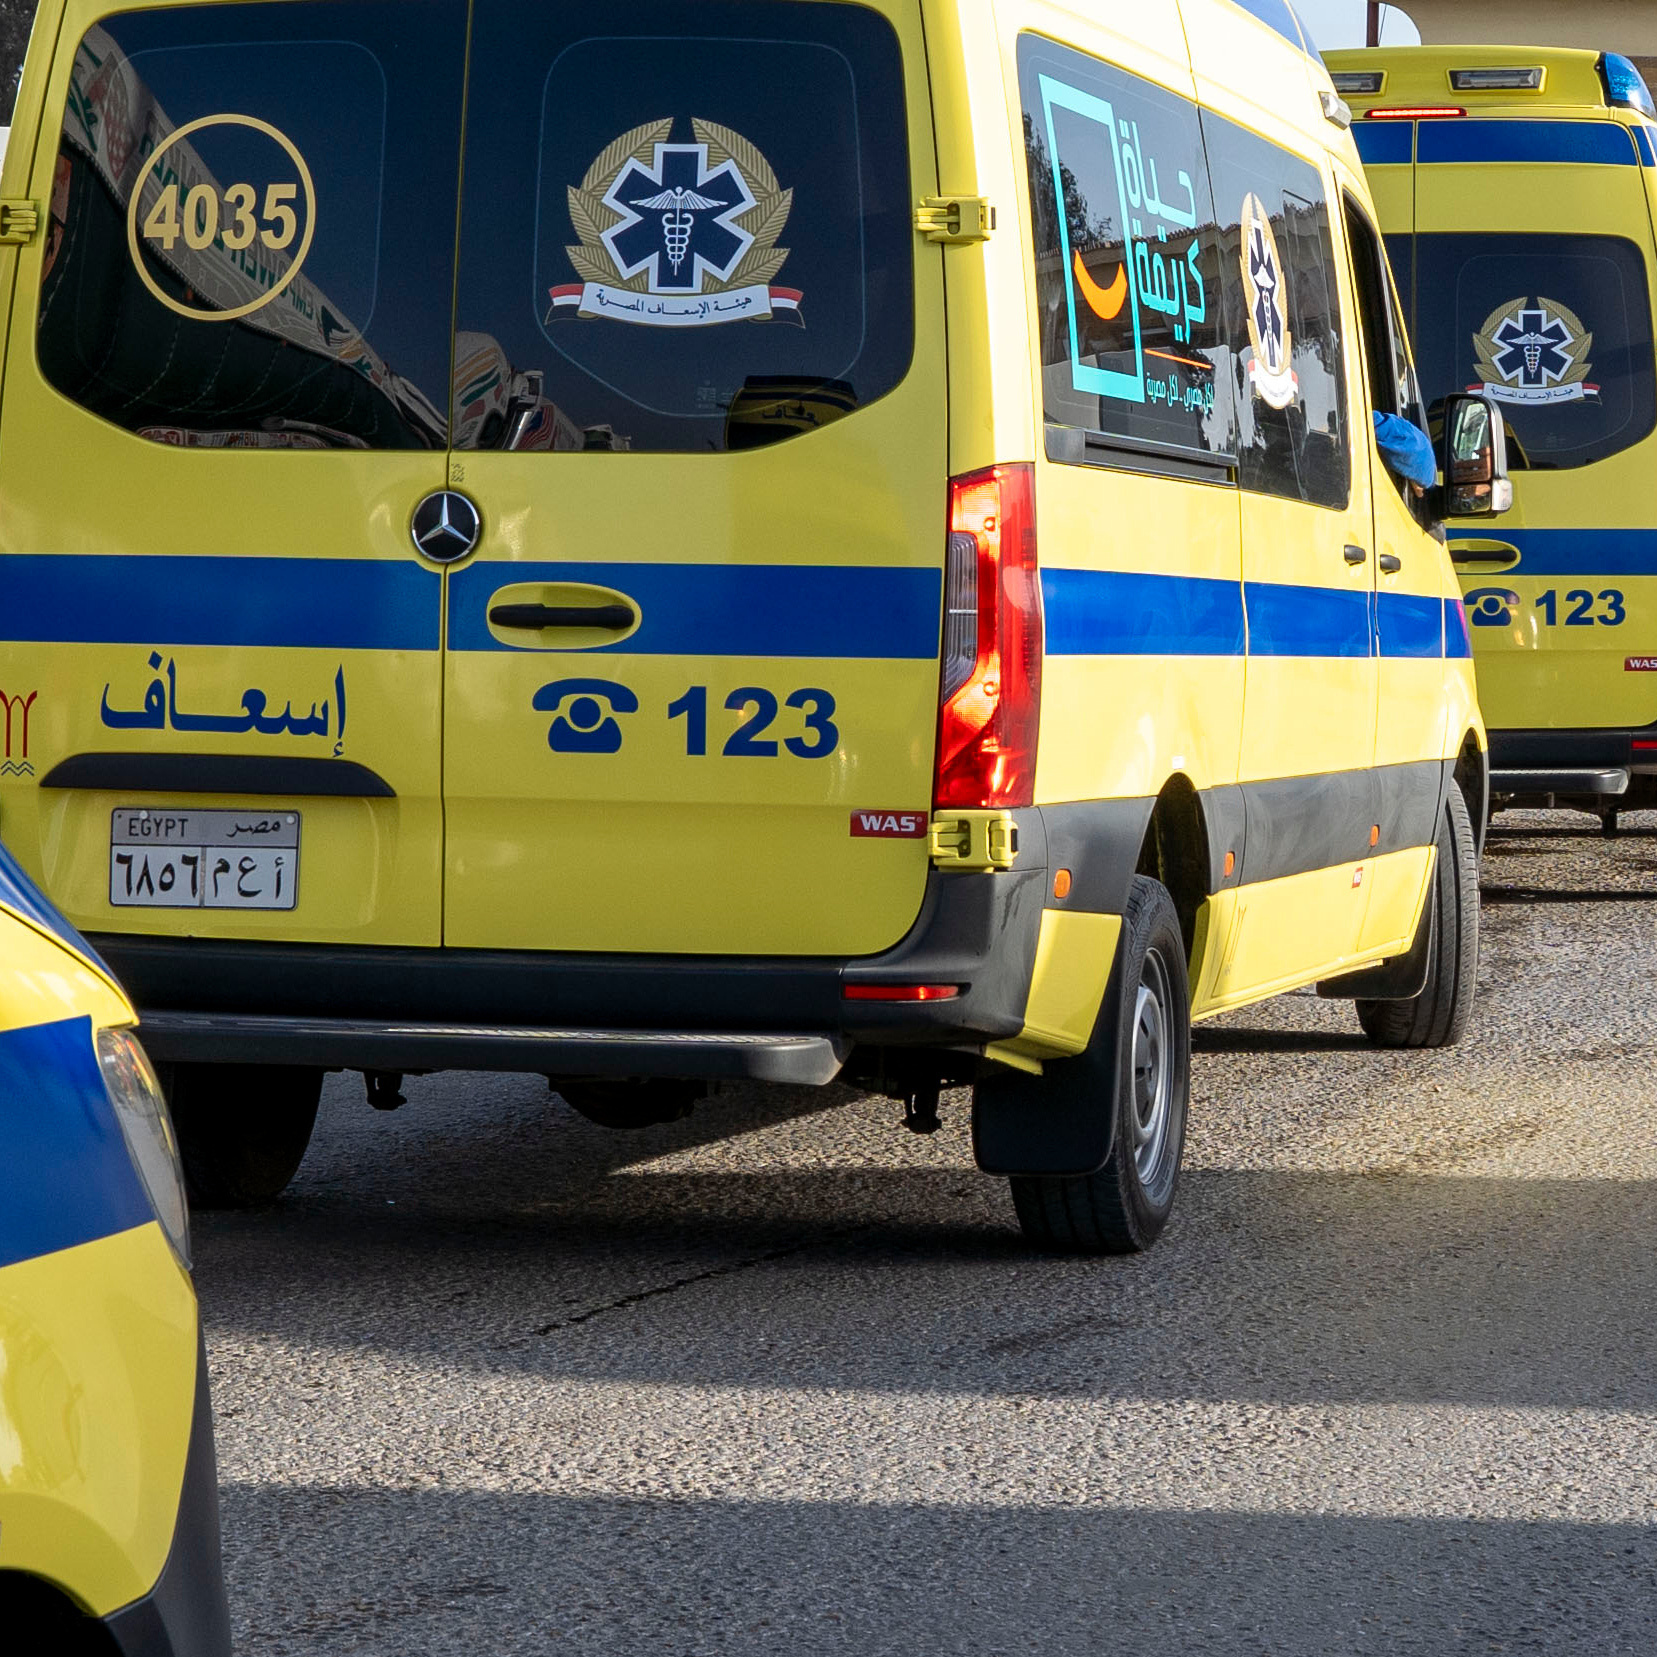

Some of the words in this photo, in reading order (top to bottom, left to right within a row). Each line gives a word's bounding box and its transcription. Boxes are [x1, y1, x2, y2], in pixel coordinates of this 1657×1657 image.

[1119, 119, 1196, 241] حياة
[143, 183, 297, 250] 4035
[596, 288, 645, 313] المصرية
[647, 301, 710, 319] الإسعاف
[713, 296, 752, 311] هيئة
[1535, 589, 1626, 626] 123
[101, 651, 346, 758] إسعاف
[666, 686, 840, 759] 123
[129, 816, 189, 838] EGYPT
[227, 820, 281, 838] مصر
[860, 814, 916, 832] WAS
[116, 853, 199, 898] ٦٨٥٦
